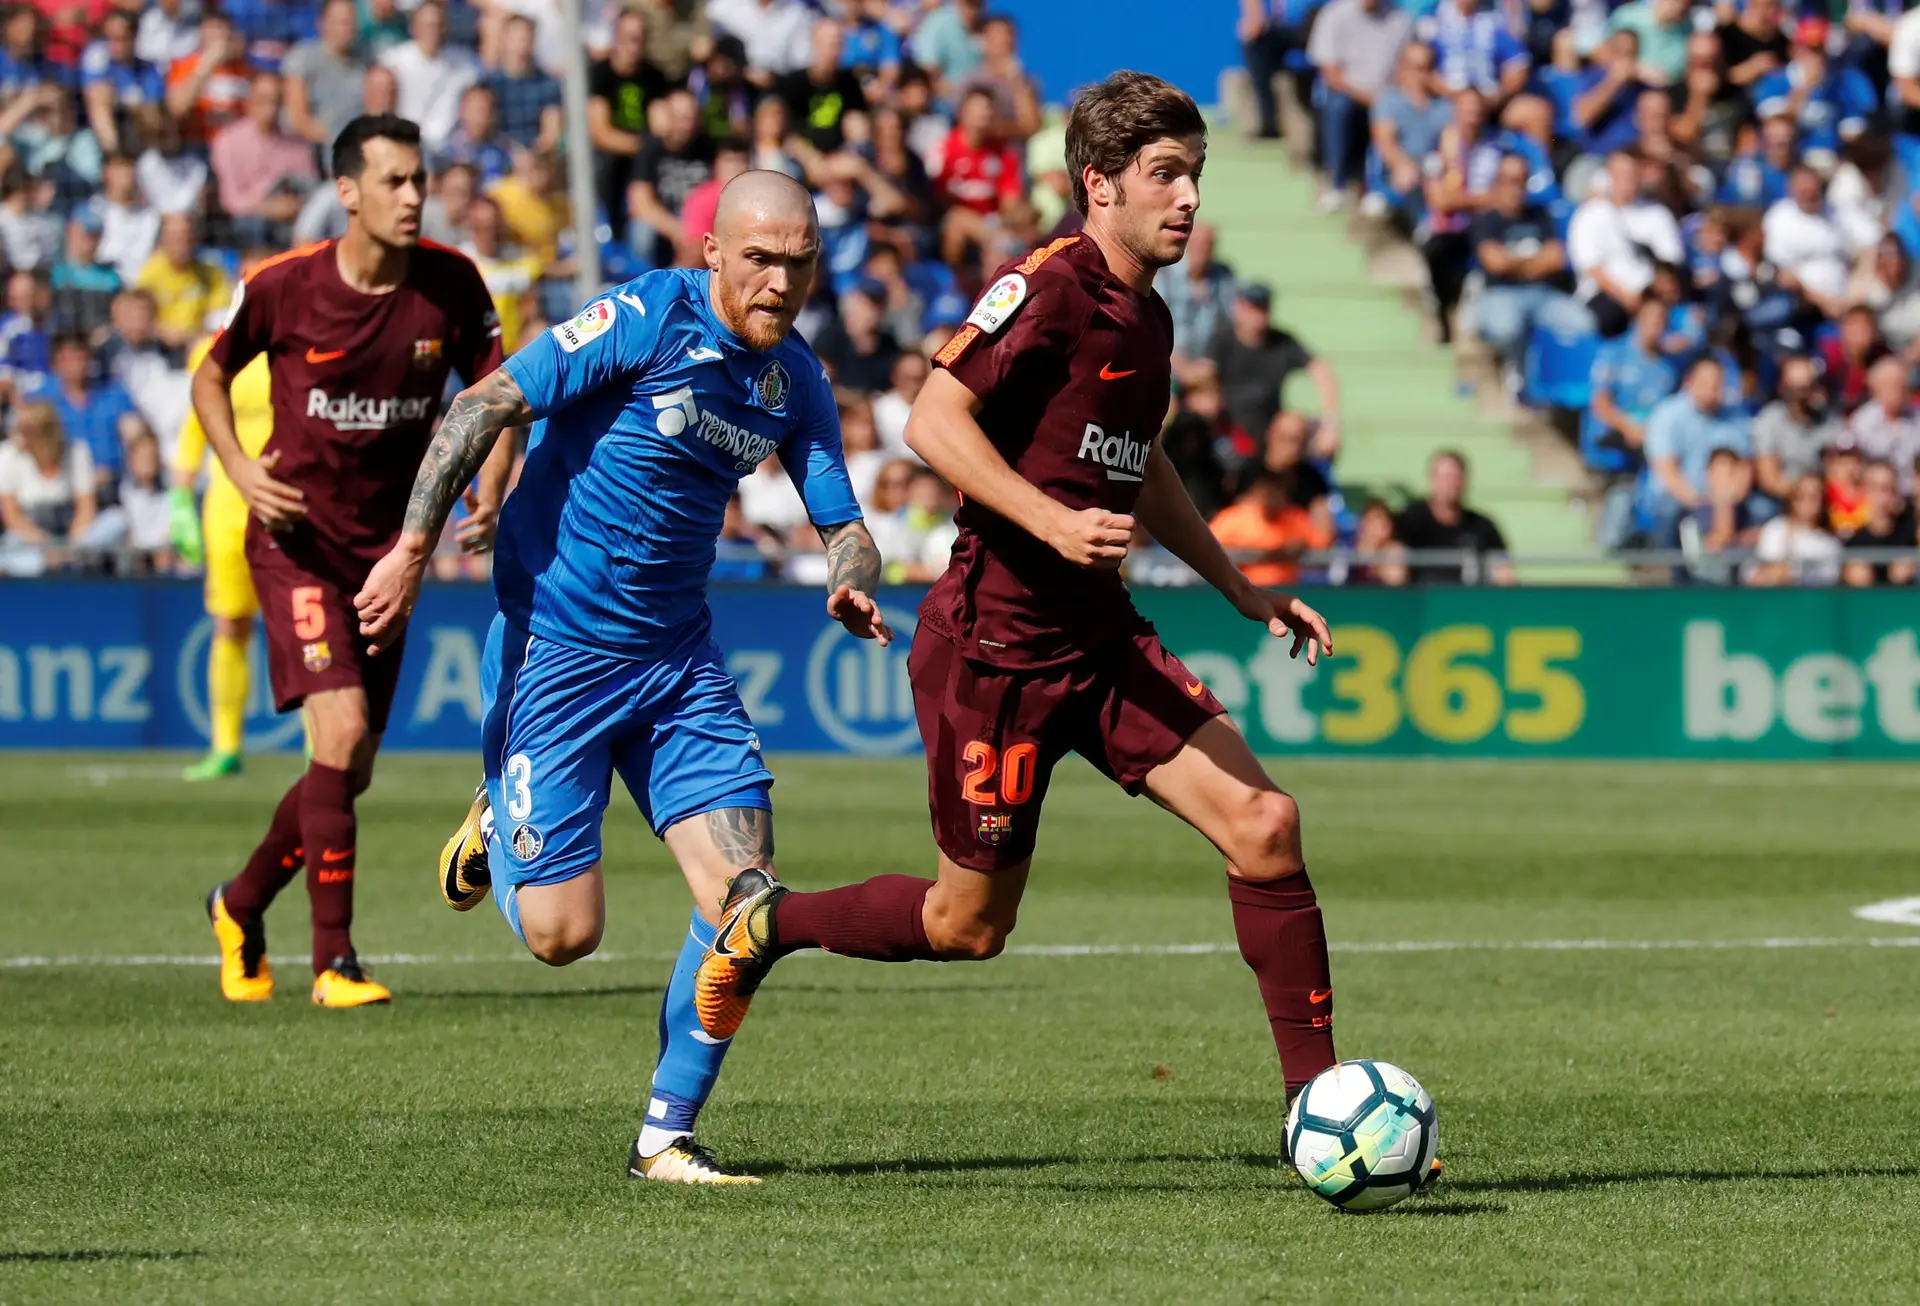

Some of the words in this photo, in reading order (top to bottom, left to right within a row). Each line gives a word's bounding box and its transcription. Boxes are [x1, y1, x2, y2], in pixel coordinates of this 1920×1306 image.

[292, 586, 325, 640] 5
[1684, 618, 1920, 744] bet
[507, 754, 532, 821] 3
[961, 741, 1037, 806] 20
